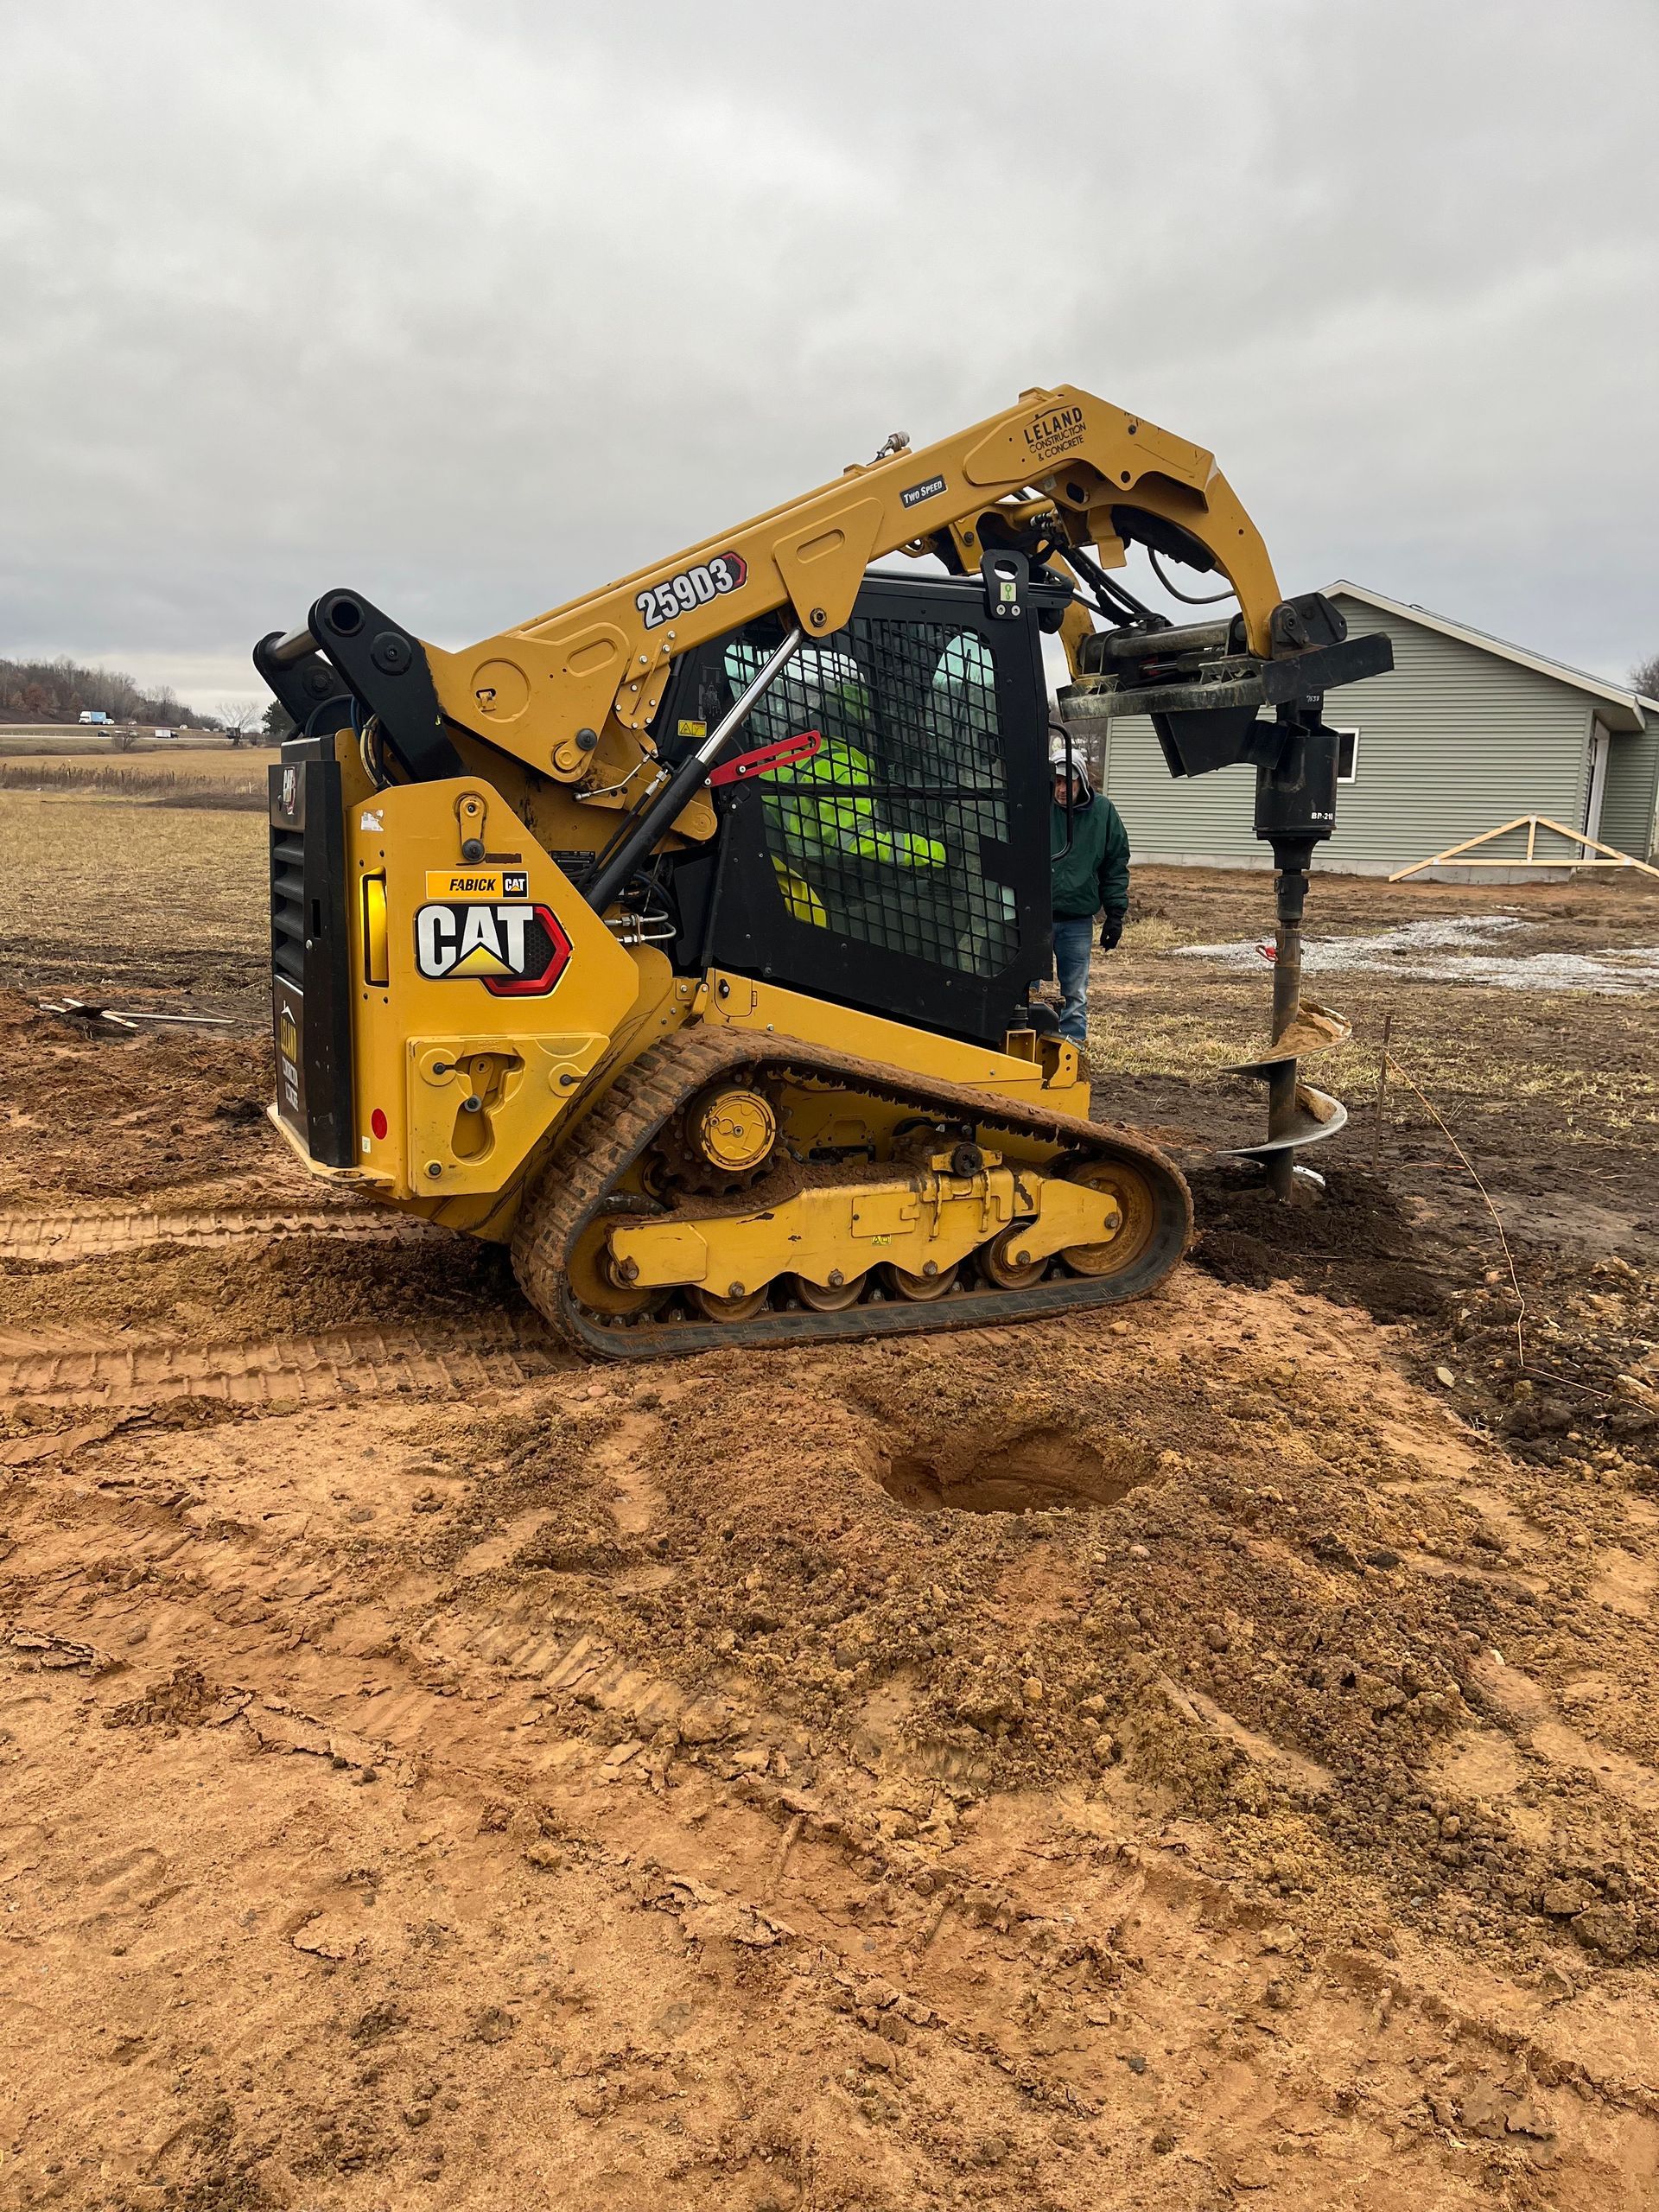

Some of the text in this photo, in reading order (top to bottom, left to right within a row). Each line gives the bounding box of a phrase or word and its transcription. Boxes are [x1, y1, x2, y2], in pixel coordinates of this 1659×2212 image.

[1024, 407, 1083, 444] LELAND
[1029, 422, 1086, 454] CONSTRUCTION
[1038, 435, 1084, 461] & CONCRETE
[637, 558, 734, 628] 259D3
[449, 878, 525, 892] FABICK CAT
[417, 906, 534, 976] CAT
